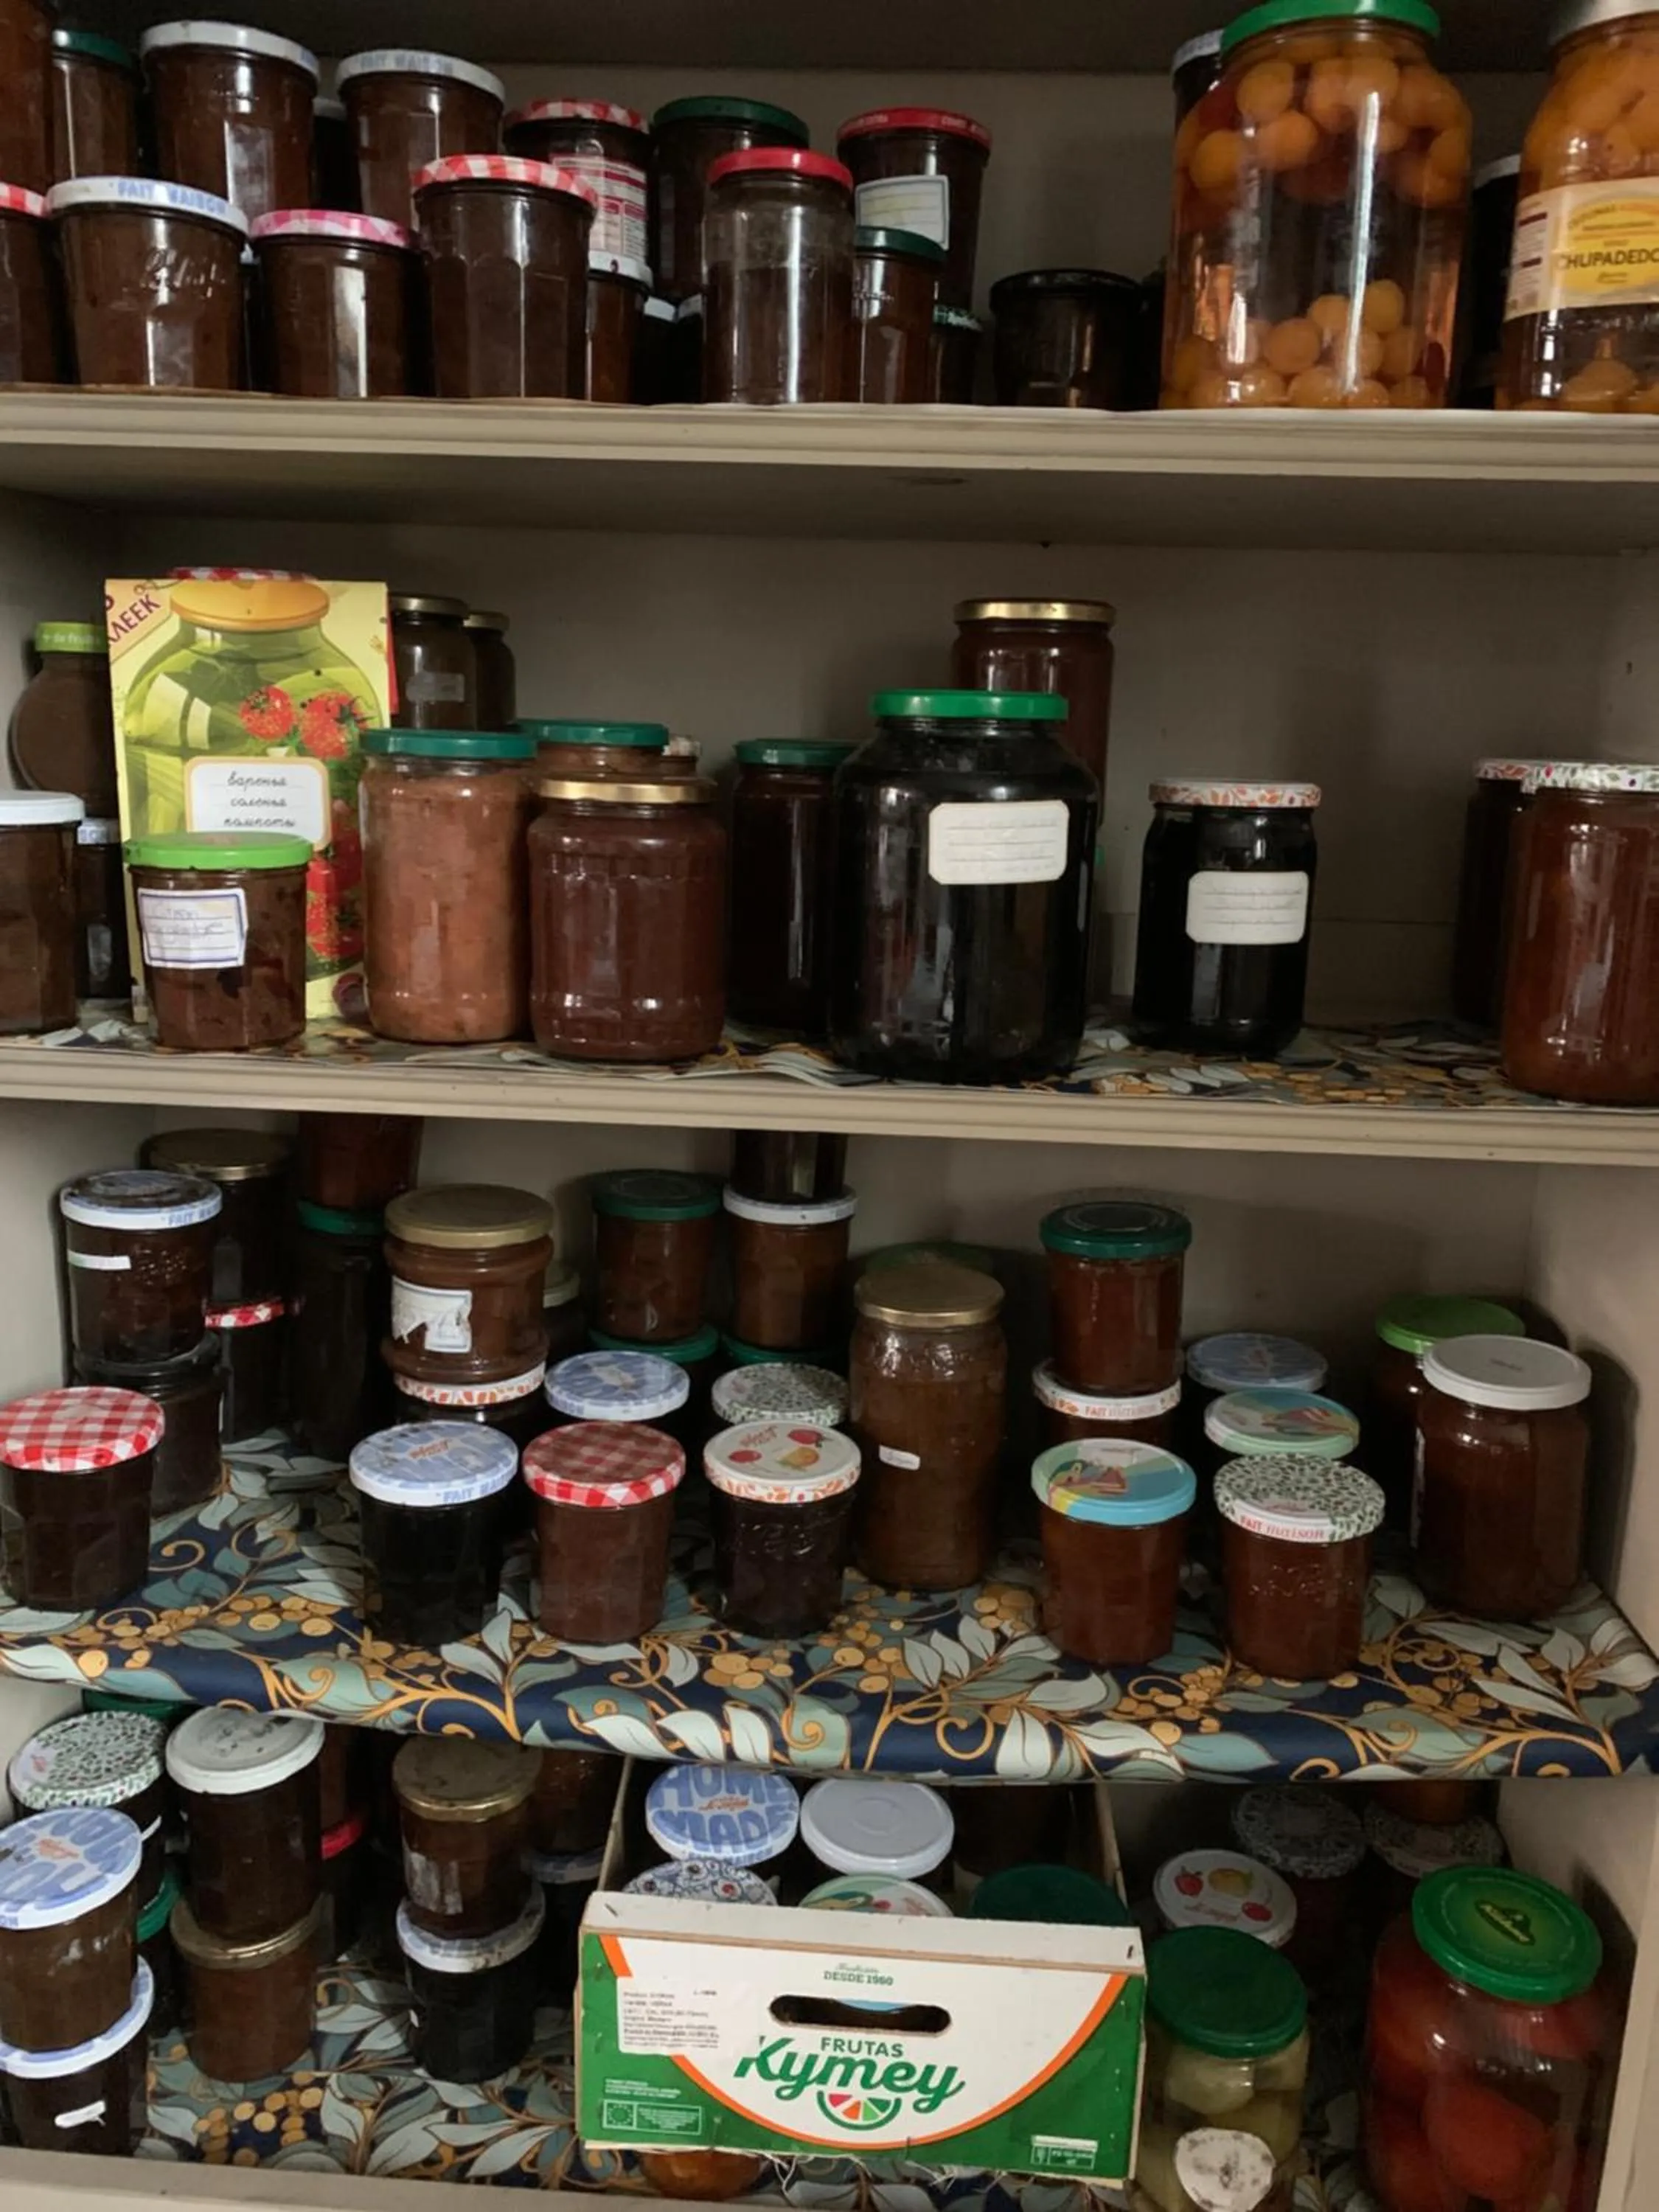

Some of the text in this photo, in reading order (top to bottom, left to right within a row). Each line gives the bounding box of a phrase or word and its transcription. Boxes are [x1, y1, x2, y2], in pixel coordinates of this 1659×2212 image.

[442, 1487, 473, 1502] FAIT
[823, 1970, 864, 1984] DESDE
[820, 2037, 904, 2058] FRUTAS
[733, 2036, 965, 2114] Kymey
